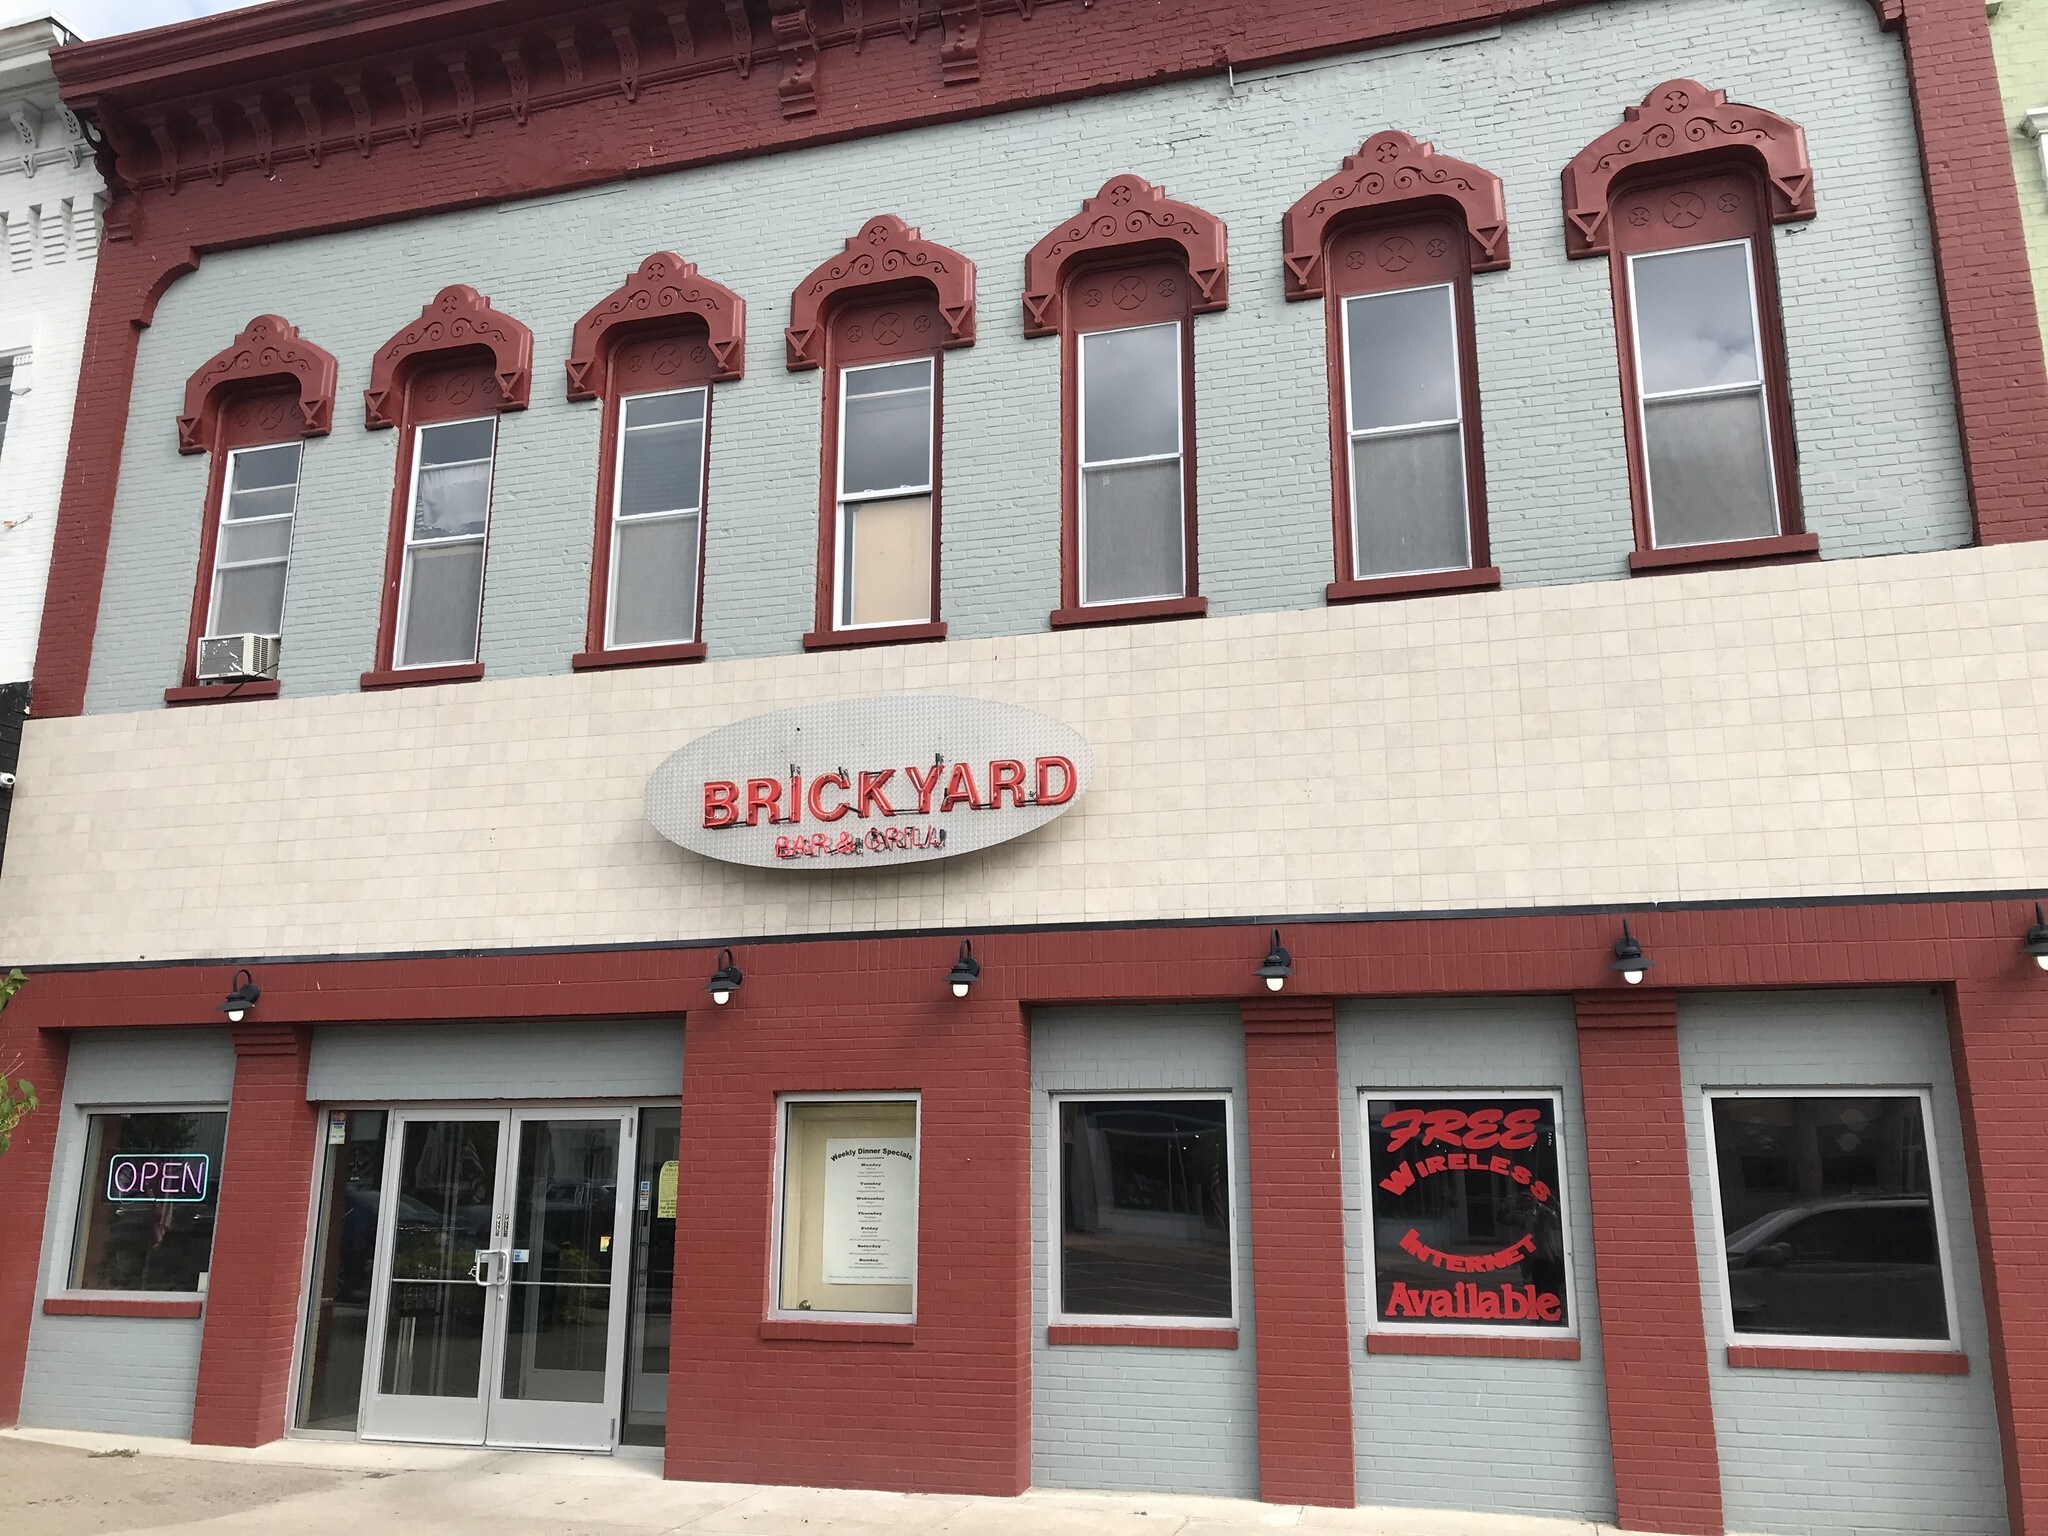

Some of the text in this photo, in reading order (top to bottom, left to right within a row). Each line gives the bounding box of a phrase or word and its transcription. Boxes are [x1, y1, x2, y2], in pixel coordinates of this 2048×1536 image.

[702, 755, 1078, 829] BRICKYARD
[775, 833, 828, 858] BAR
[836, 831, 856, 854] &
[1381, 1109, 1541, 1152] FREE
[830, 1149, 856, 1162] Weekly
[882, 1147, 913, 1161] Specials
[114, 1161, 204, 1194] OPEN
[1379, 1153, 1552, 1202] WIRELESS
[1399, 1228, 1537, 1273] INTERNET
[1385, 1281, 1562, 1322] Available
